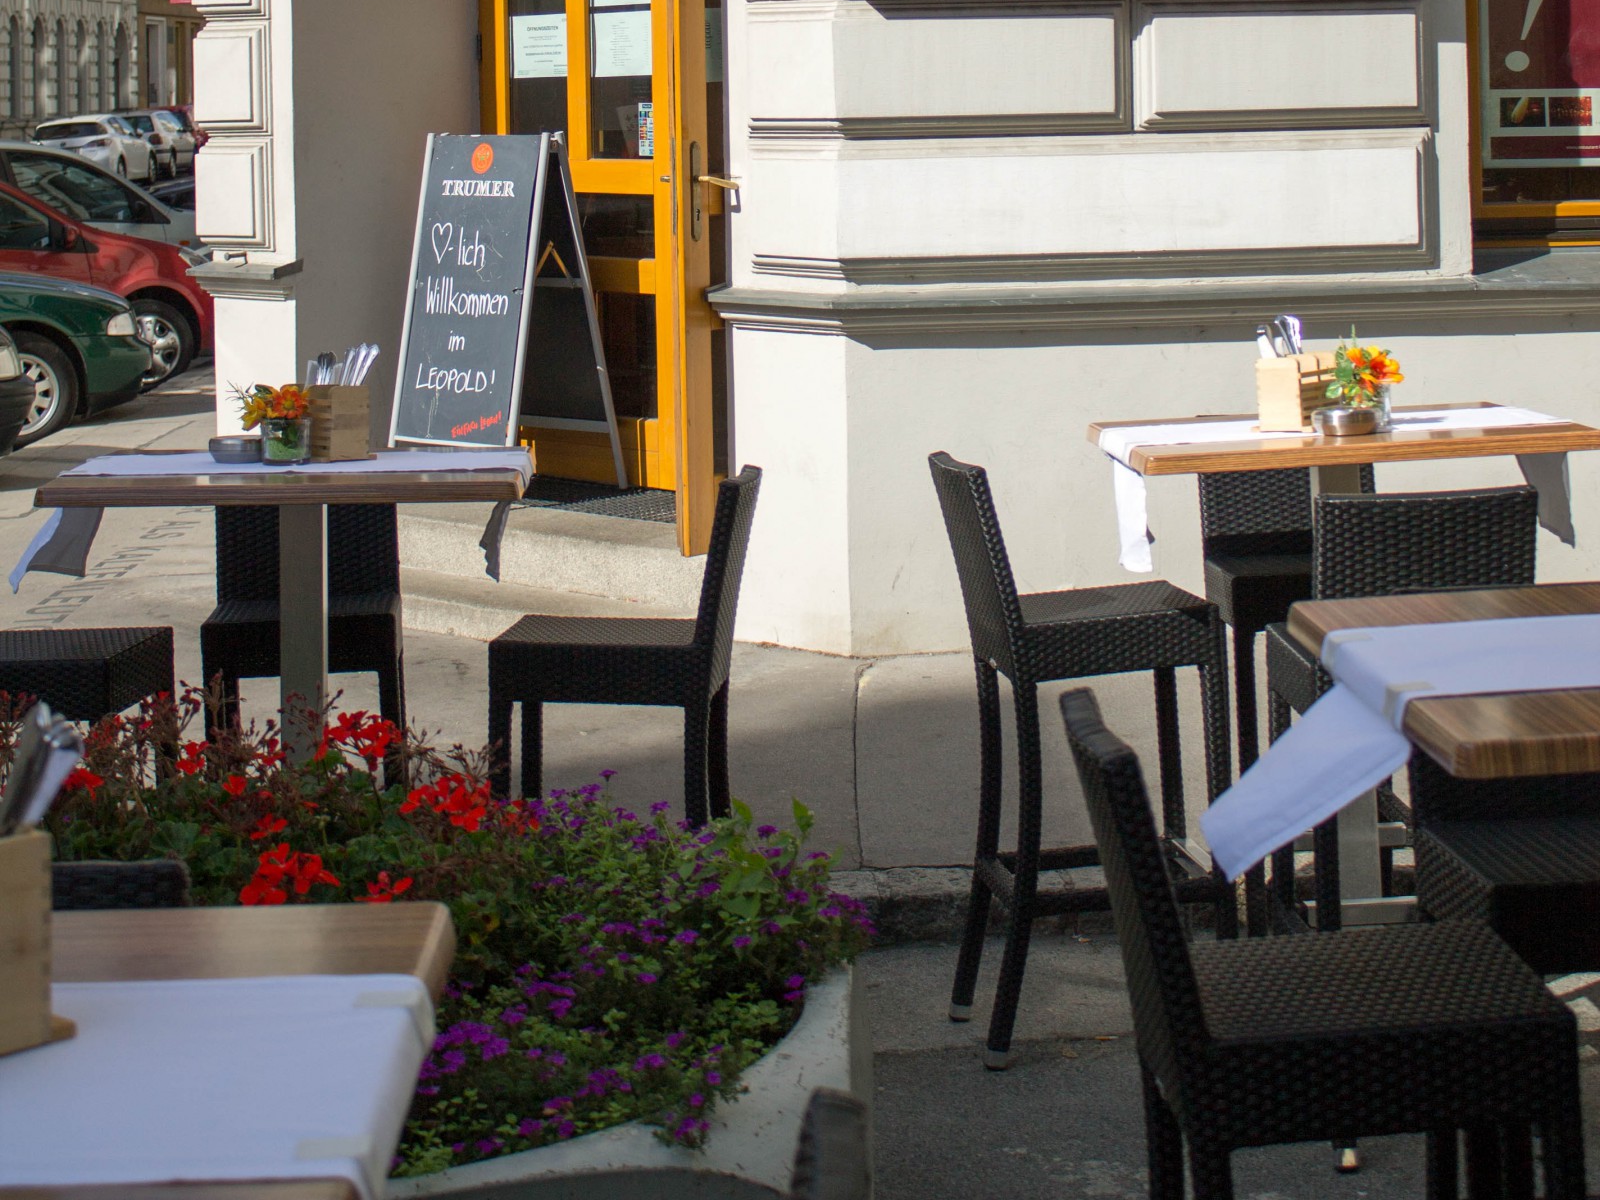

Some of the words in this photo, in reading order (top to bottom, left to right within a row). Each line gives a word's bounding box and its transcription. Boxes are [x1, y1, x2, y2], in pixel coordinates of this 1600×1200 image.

[441, 179, 515, 198] TRUMER
[426, 275, 509, 318] Willkommen
[448, 330, 466, 352] im
[7, 545, 167, 629] KALTENLEUT
